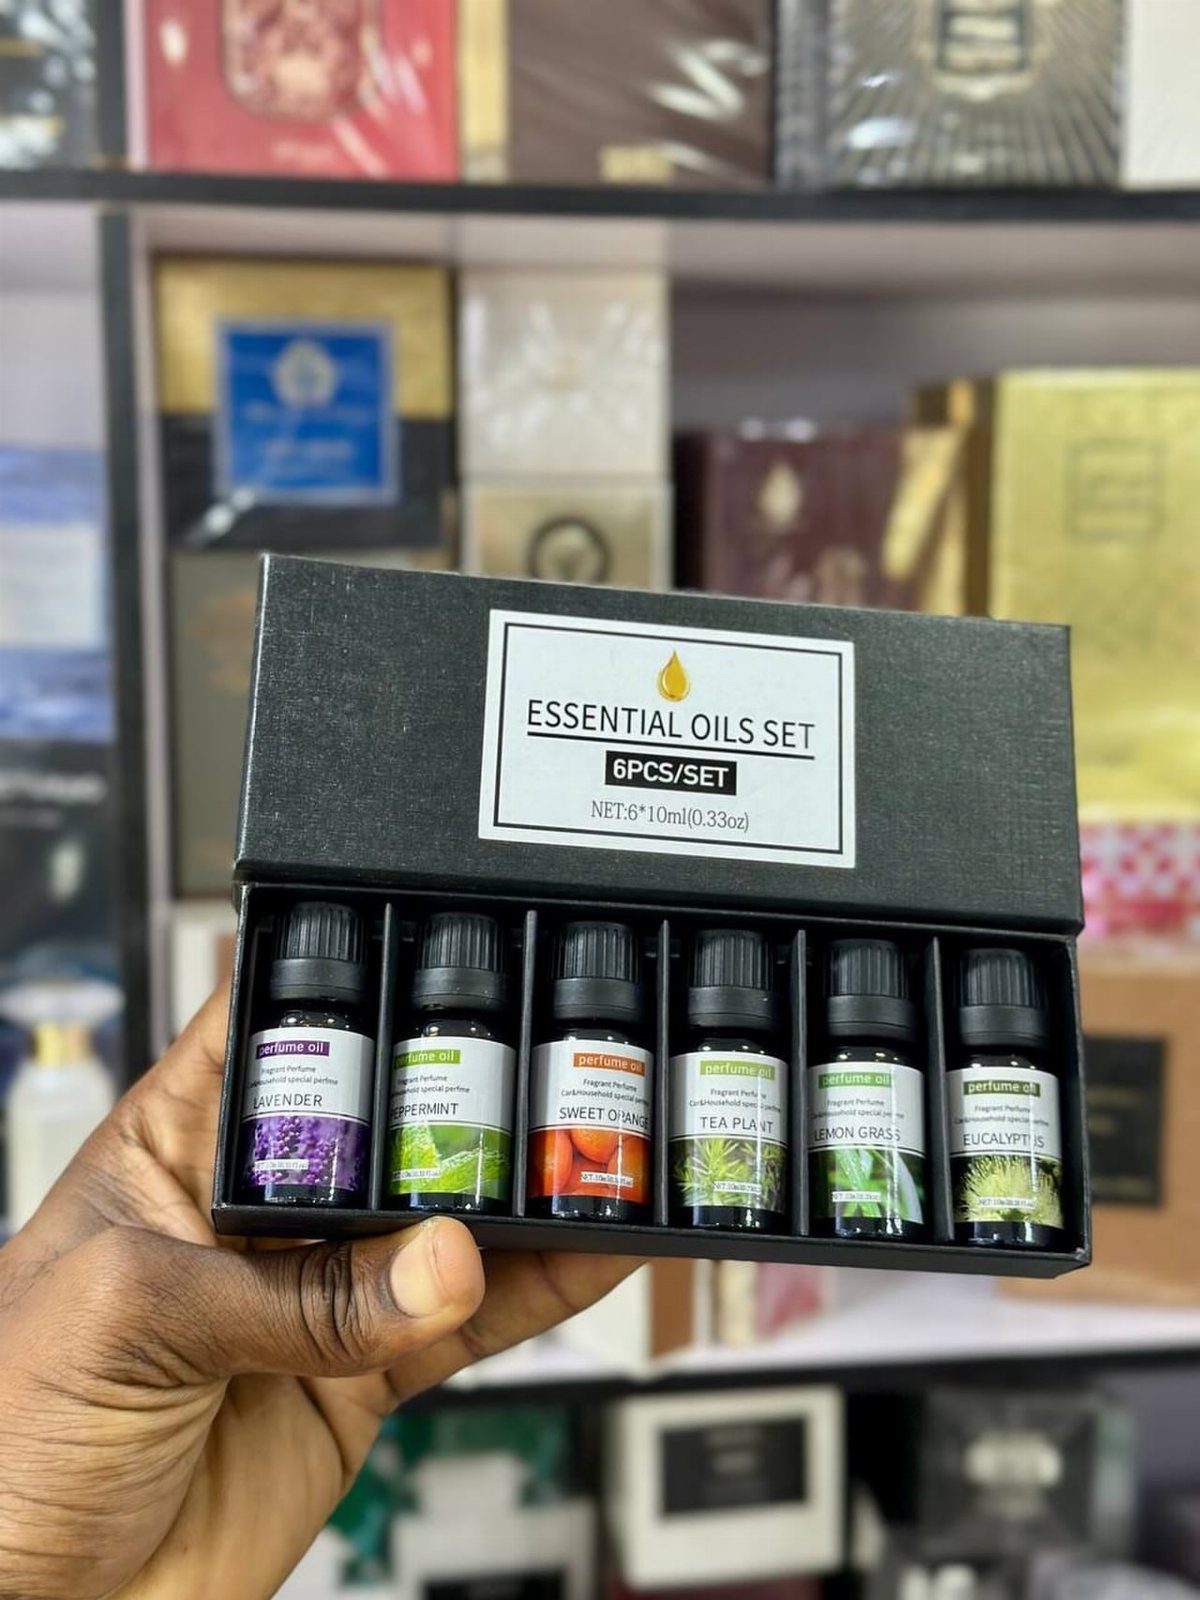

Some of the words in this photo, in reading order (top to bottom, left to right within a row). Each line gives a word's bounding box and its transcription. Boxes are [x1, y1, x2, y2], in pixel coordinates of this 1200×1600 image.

[527, 699, 683, 738] ESSENTIAL
[690, 713, 755, 744] OILS
[762, 720, 815, 750] SET
[612, 757, 729, 789] 6PCS/SET
[259, 1041, 304, 1055] perfume
[308, 1042, 324, 1052] oil
[440, 1050, 454, 1062] oil
[578, 1055, 628, 1070] perfume
[631, 1061, 642, 1071] oil
[286, 1065, 316, 1073] Perfume
[705, 1065, 756, 1076] perfume
[288, 1076, 312, 1085] special
[583, 1078, 611, 1088] Fragrant
[612, 1081, 637, 1092] Perfume
[822, 1073, 872, 1086] perfume
[875, 1074, 890, 1084] oil
[421, 1085, 444, 1094] special
[710, 1088, 740, 1098] Fragrant
[968, 1081, 1020, 1094] perfume
[253, 1094, 322, 1109] LAVENDER
[389, 1103, 458, 1120] PEPPERMINT
[559, 1107, 604, 1120] SWEET
[608, 1108, 650, 1130] ORANGE
[700, 1116, 728, 1129] TEA
[732, 1117, 773, 1133] PLANT
[814, 1127, 855, 1141] LEMON
[858, 1127, 901, 1141] GRASS
[963, 1133, 1045, 1148] EUCALYPTUS
